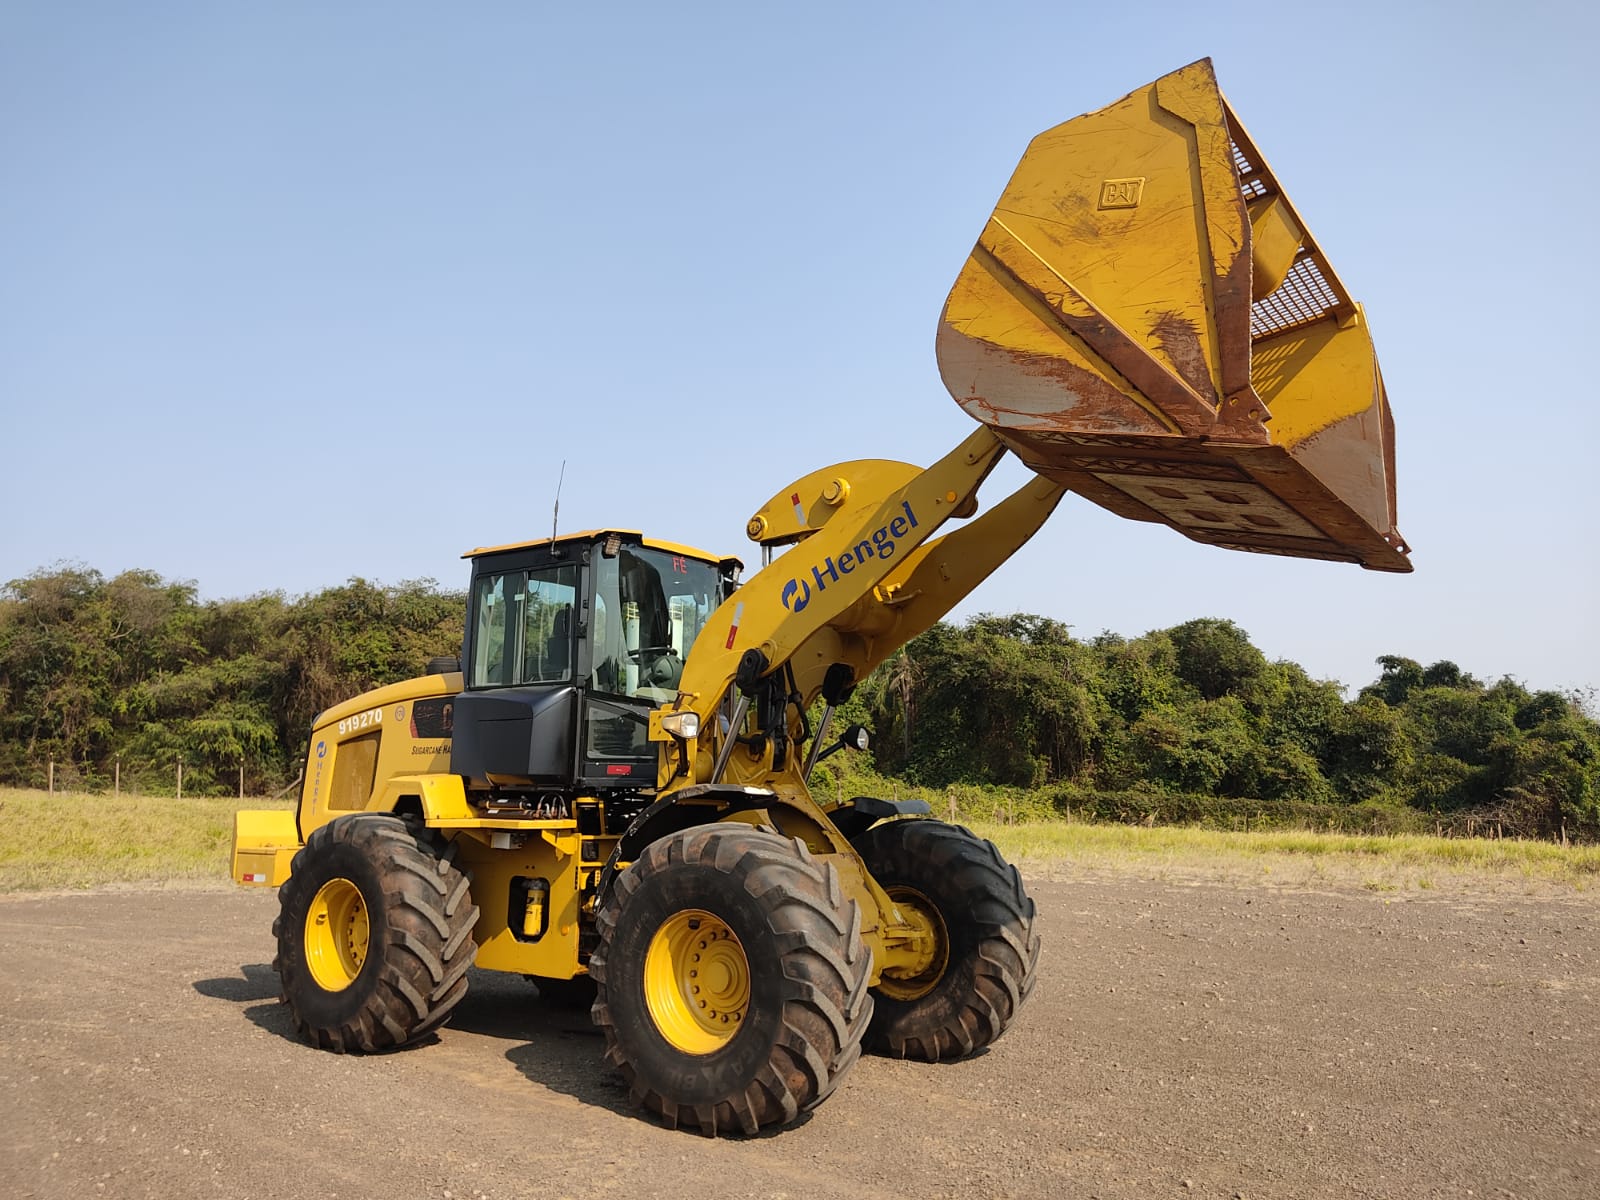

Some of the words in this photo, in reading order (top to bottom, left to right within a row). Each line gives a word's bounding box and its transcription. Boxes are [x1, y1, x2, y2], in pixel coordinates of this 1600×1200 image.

[1106, 181, 1139, 204] CAT
[811, 500, 919, 592] Hengel
[339, 708, 382, 735] 919270
